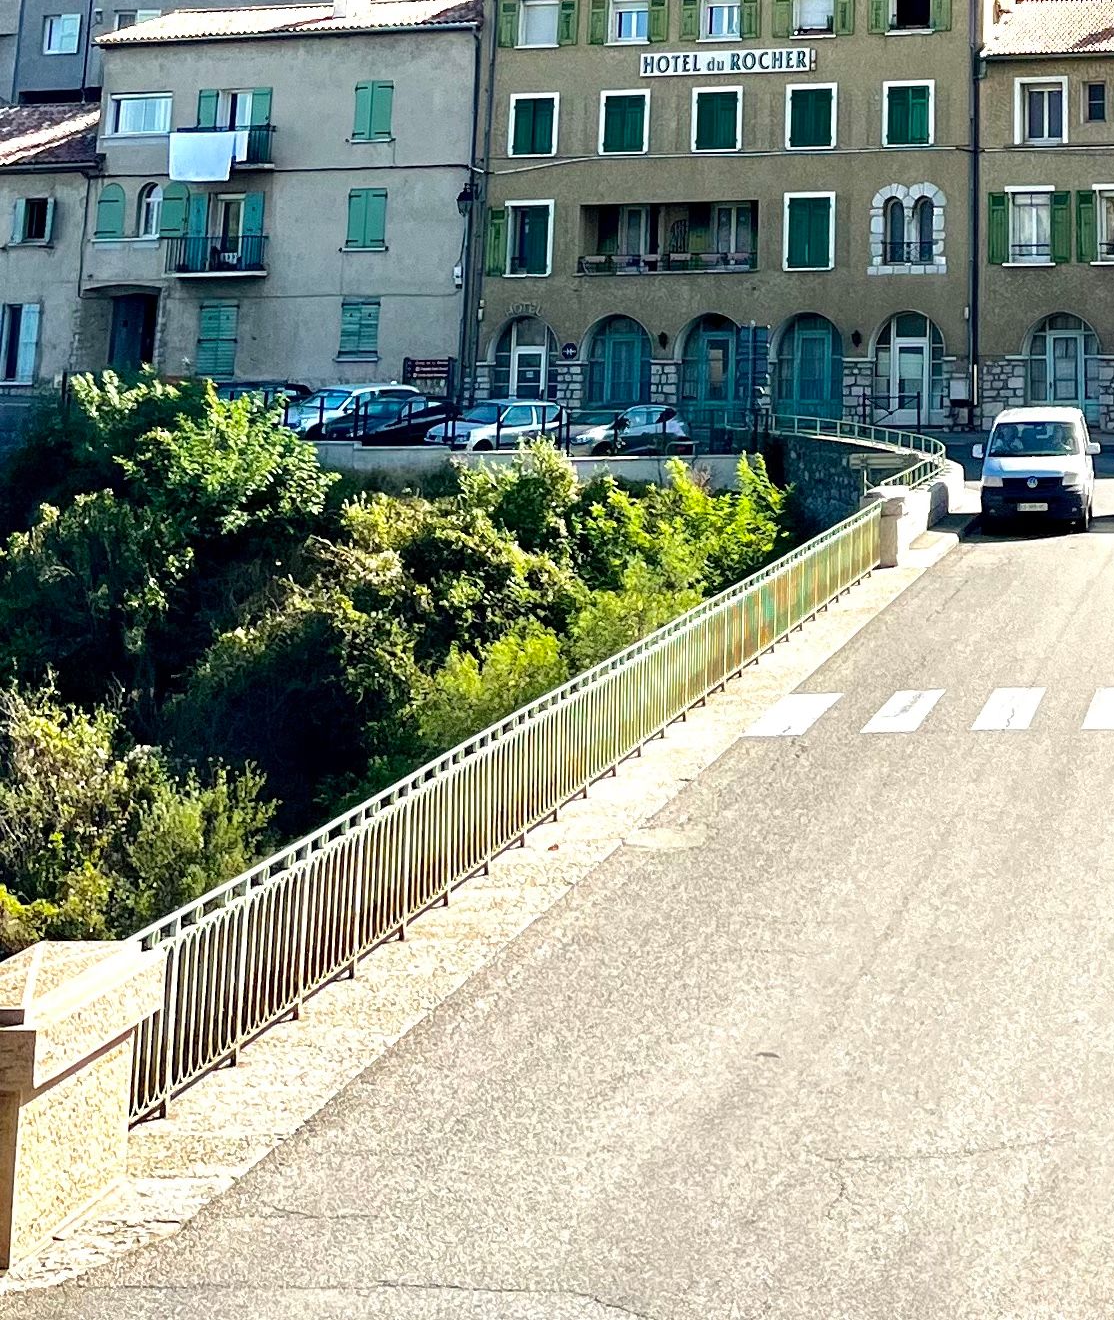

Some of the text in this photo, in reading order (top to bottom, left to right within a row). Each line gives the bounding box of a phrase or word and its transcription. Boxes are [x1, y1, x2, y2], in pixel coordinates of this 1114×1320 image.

[642, 50, 808, 74] HOTEL du ROCHER
[504, 302, 542, 317] HOTEL
